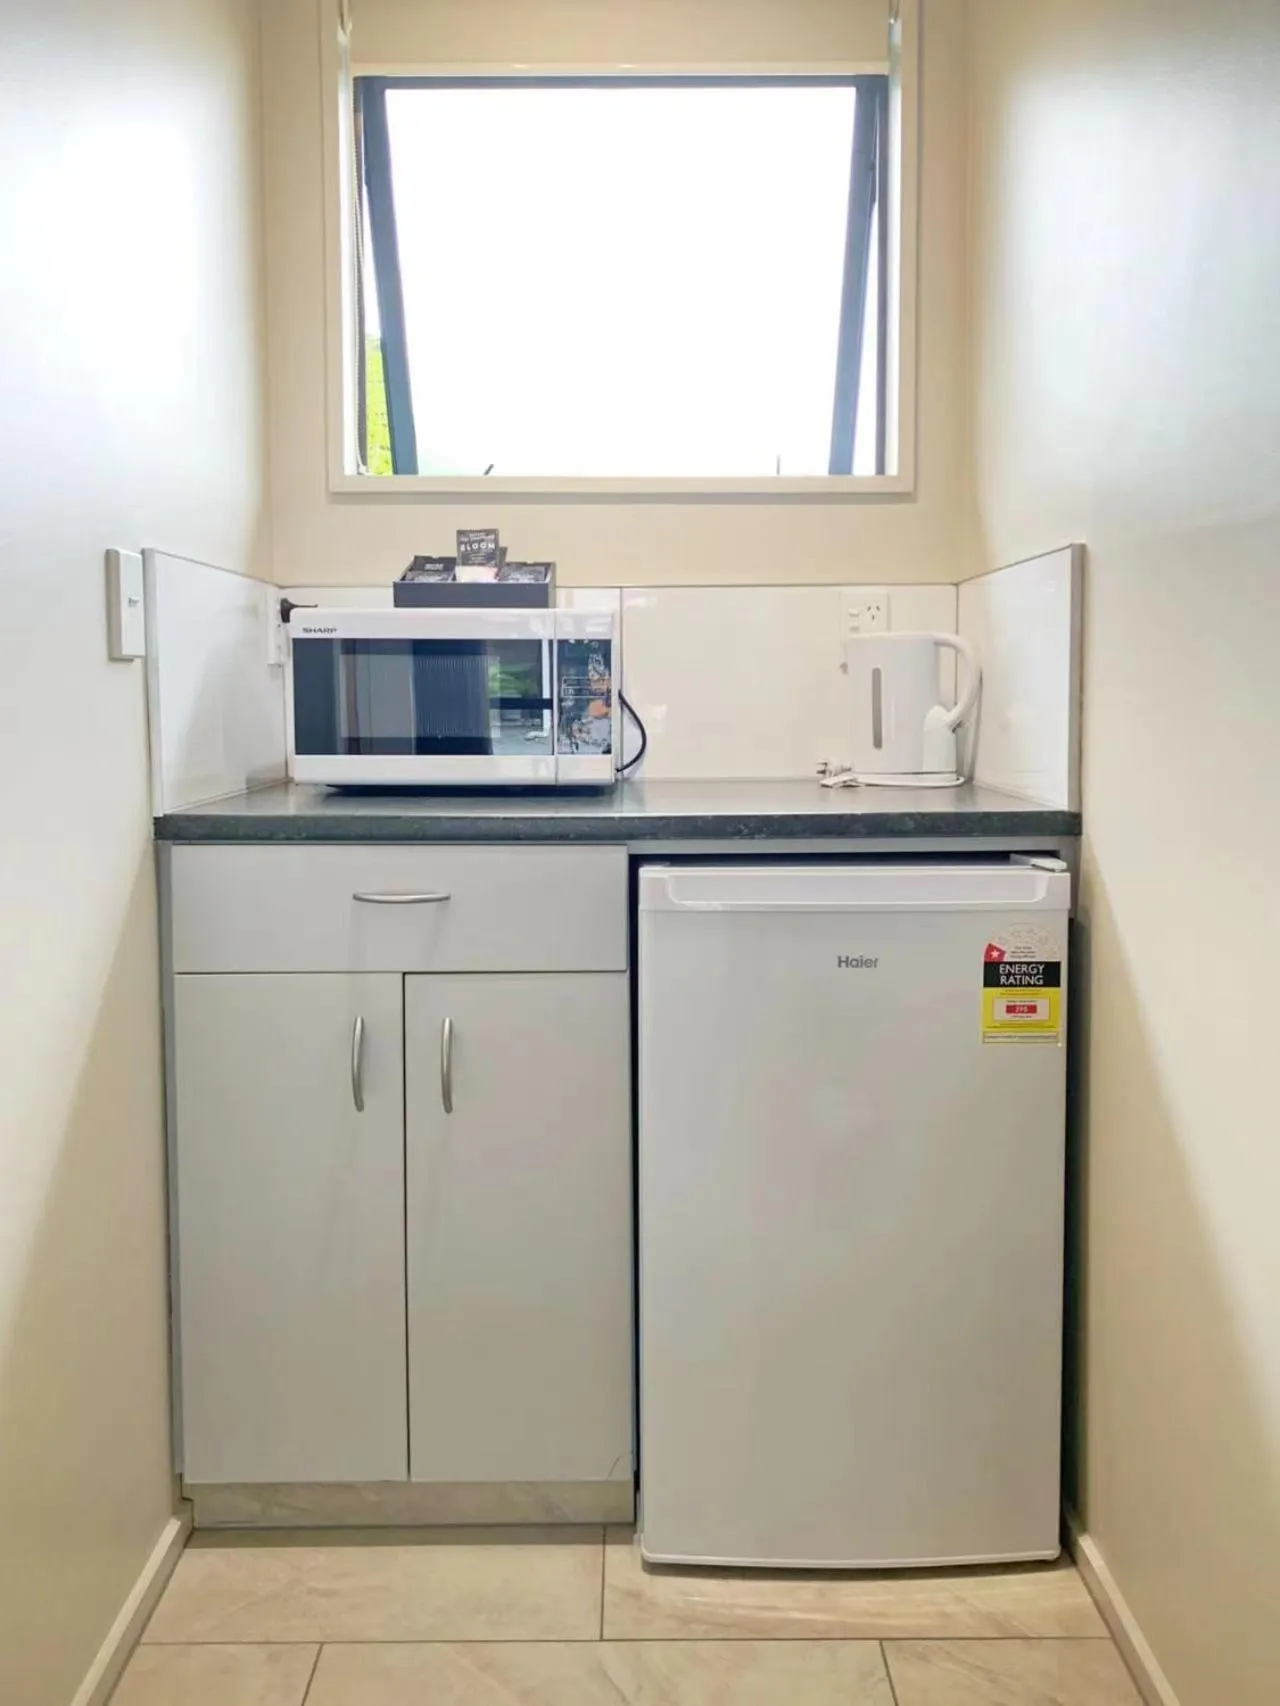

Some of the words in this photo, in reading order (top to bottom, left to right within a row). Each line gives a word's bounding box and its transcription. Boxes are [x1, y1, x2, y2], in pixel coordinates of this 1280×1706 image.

[837, 955, 879, 968] Haier
[999, 963, 1045, 974] ENERGY
[1000, 975, 1044, 985] RATING
